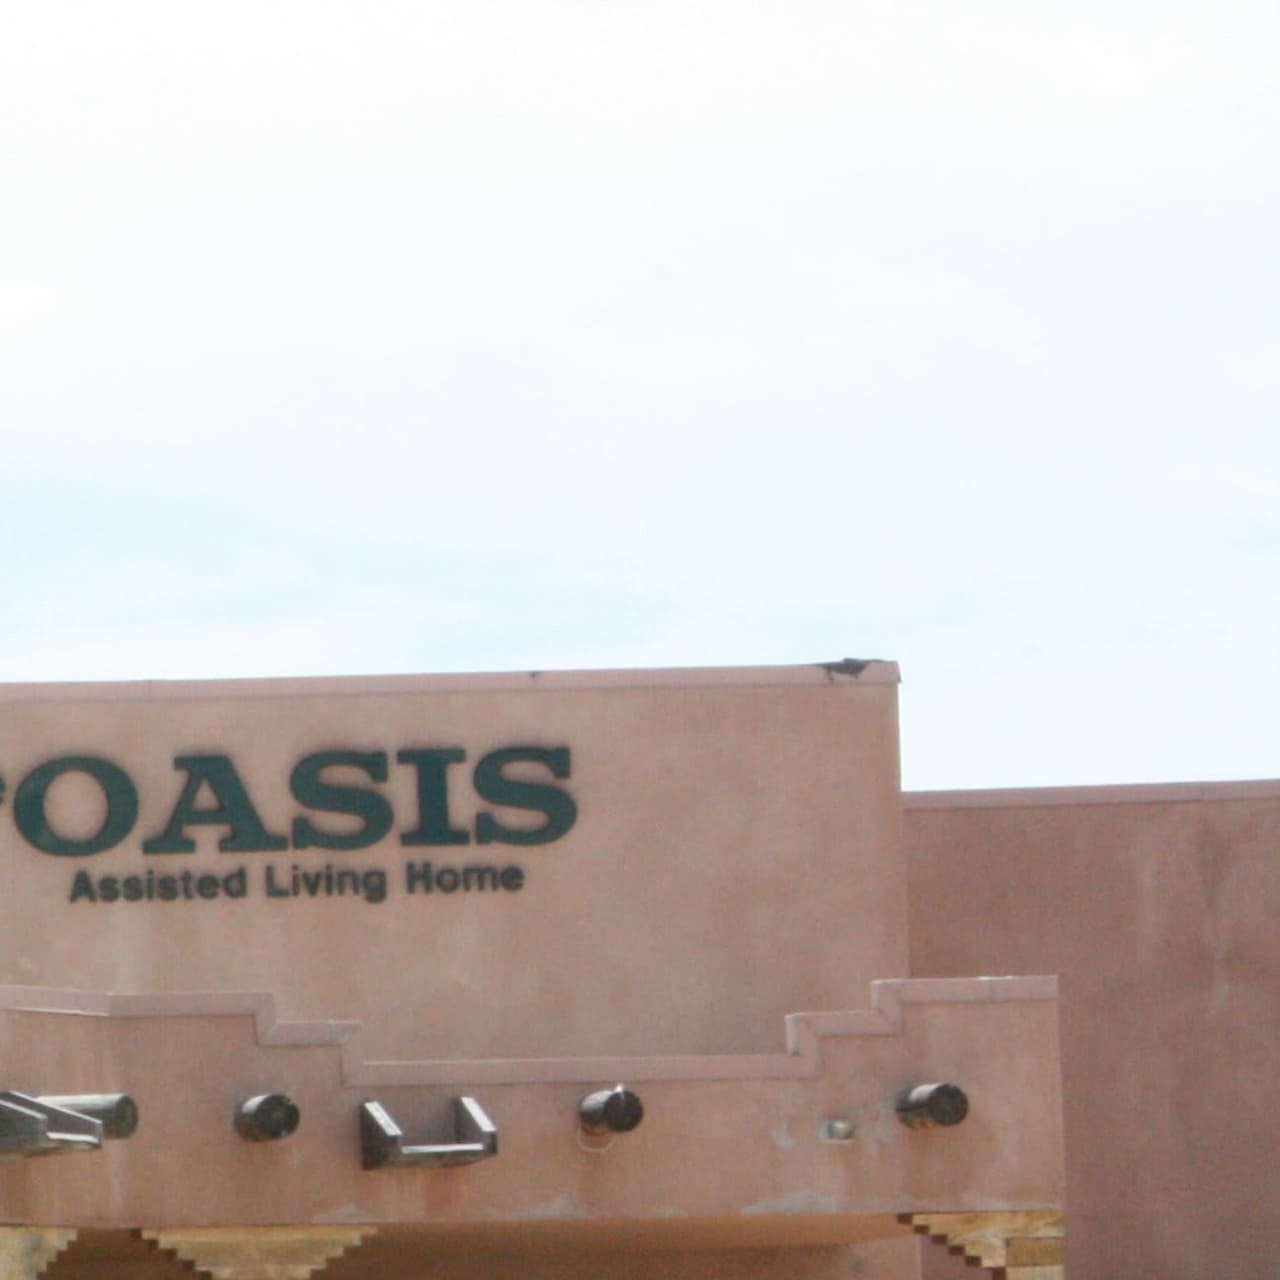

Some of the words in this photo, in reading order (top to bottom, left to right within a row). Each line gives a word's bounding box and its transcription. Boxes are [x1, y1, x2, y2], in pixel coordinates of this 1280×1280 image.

[11, 745, 579, 856] OASIS
[69, 865, 248, 903] Assisted
[265, 863, 388, 904] Living
[405, 860, 525, 894] Home
